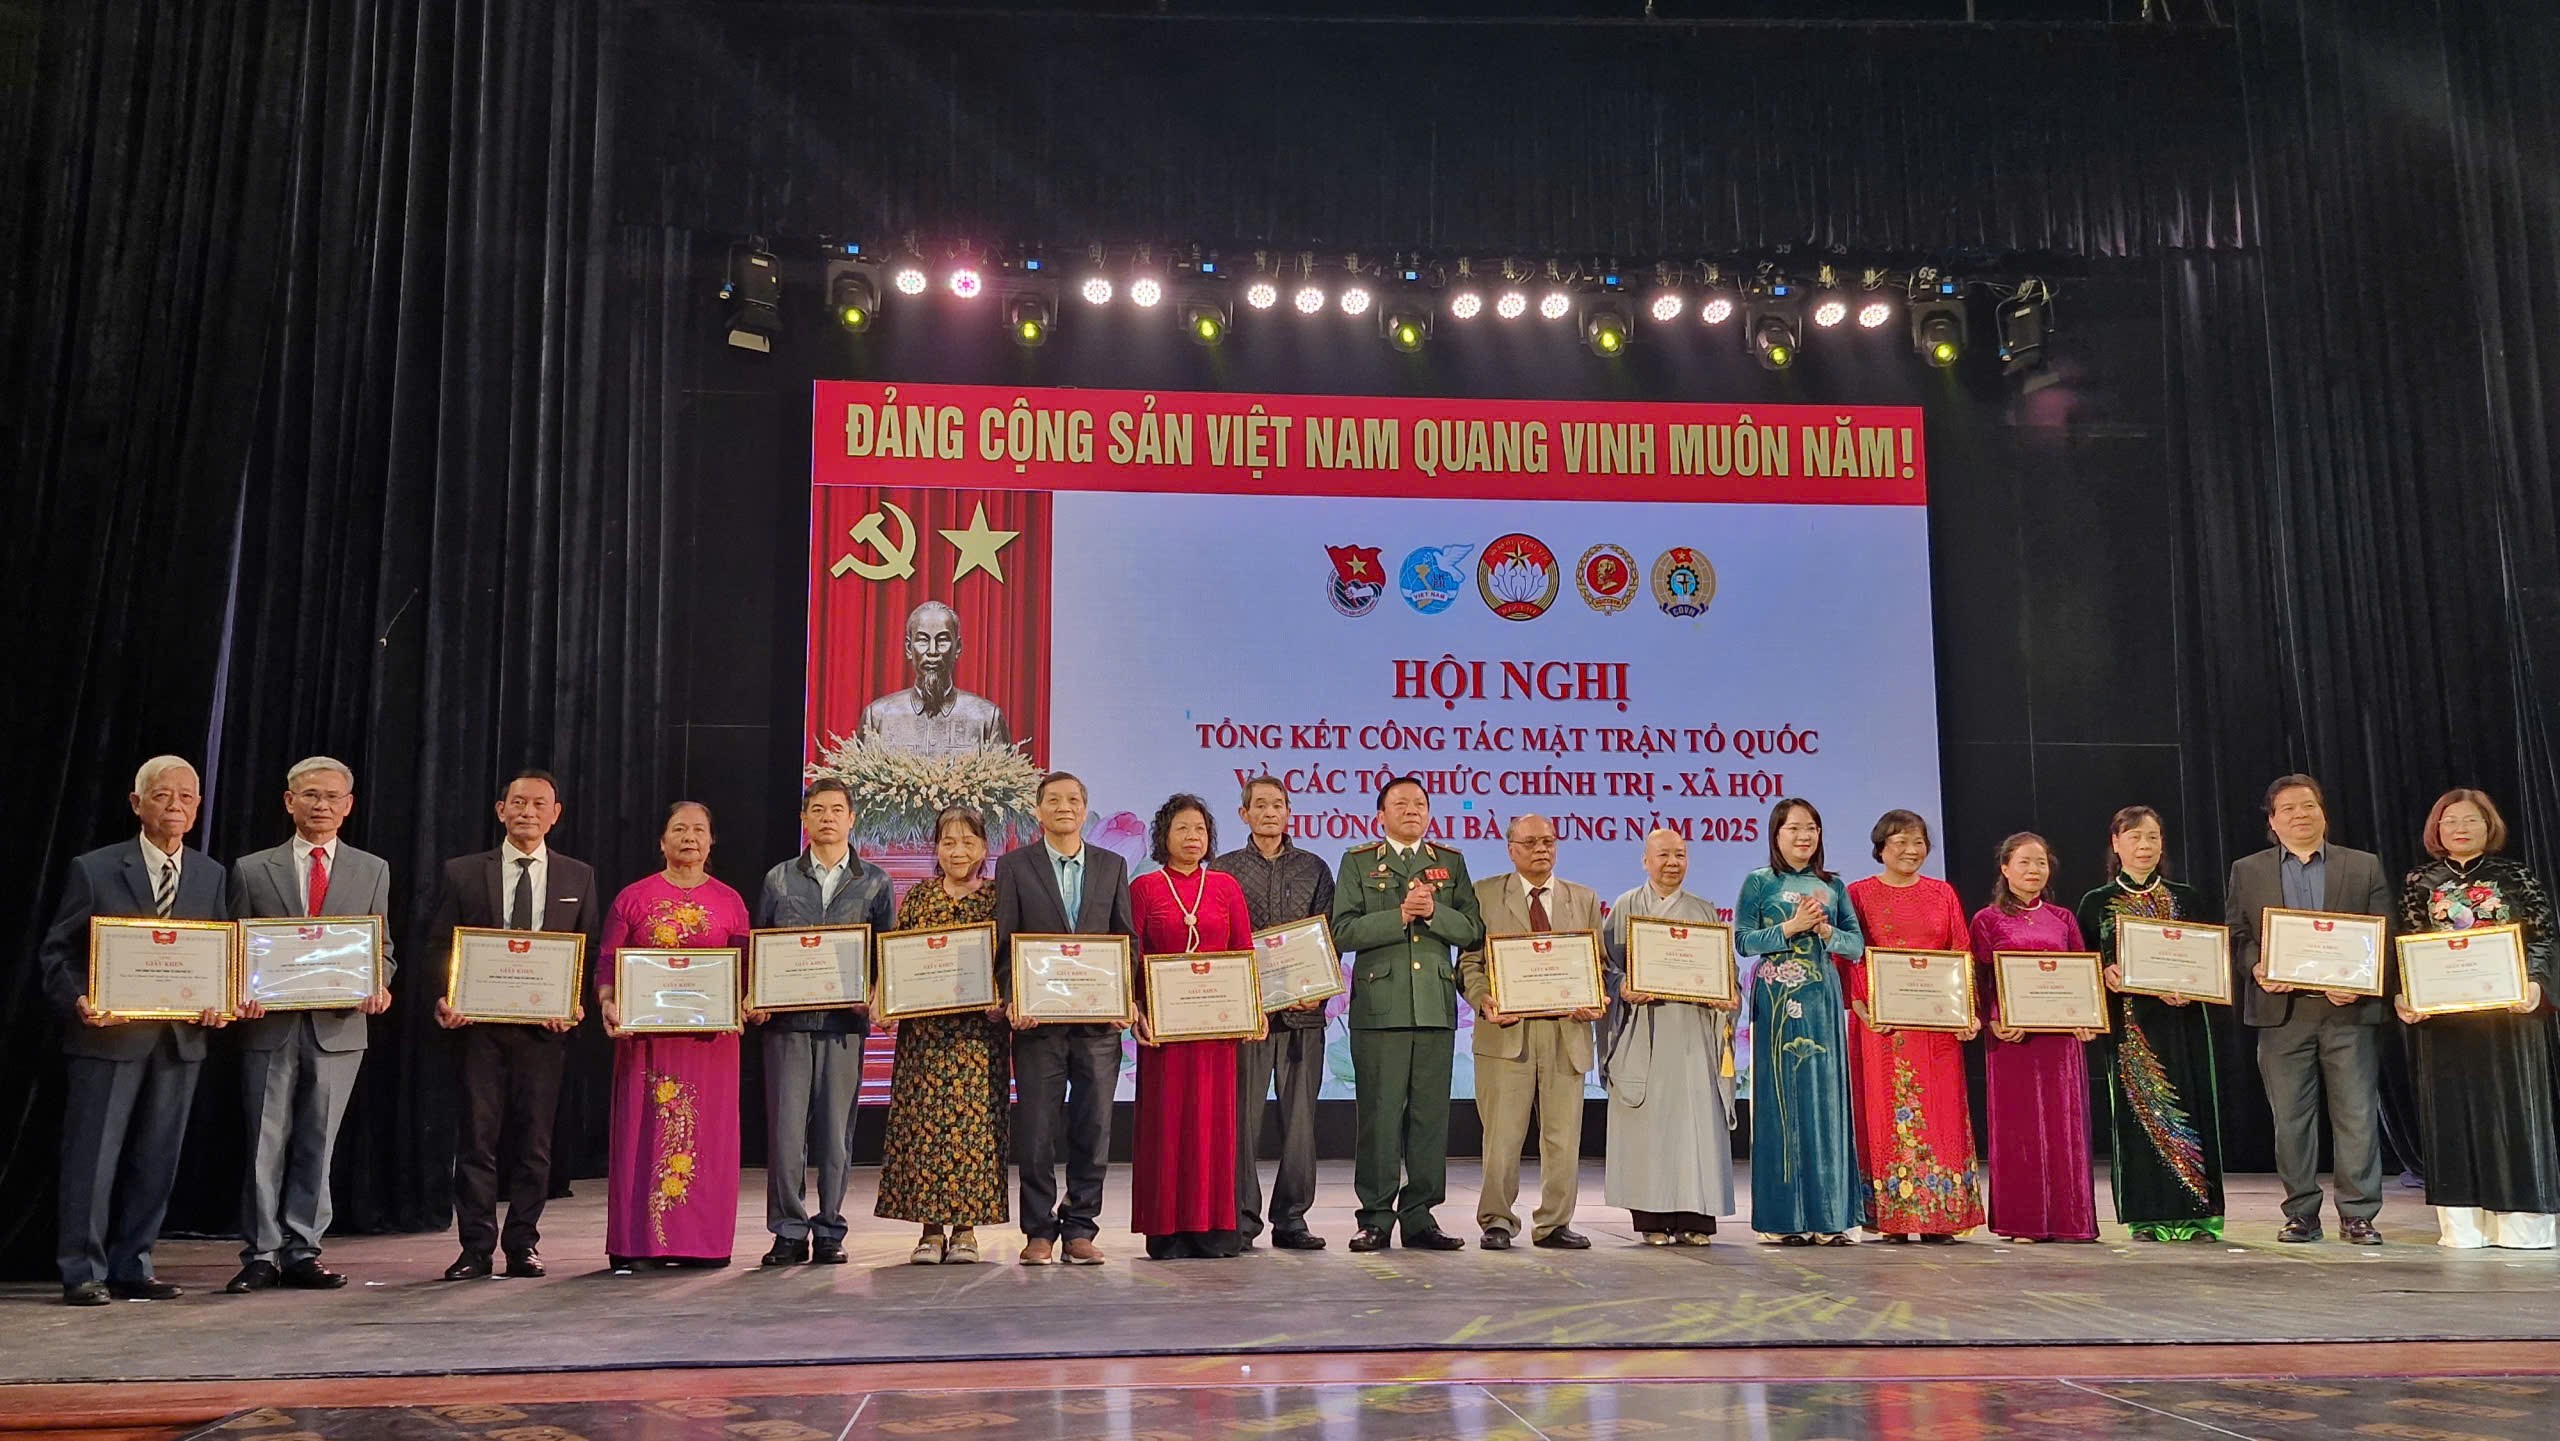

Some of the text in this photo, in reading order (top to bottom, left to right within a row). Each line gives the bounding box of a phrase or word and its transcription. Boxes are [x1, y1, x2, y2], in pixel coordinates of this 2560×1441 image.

[845, 386, 1914, 479] ĐẢNG CỘNG SẢN VIỆT NAM QUANG VINH MUÔN NĂM!
[1391, 653, 1631, 713] HỘI NGHỊ
[1195, 717, 1819, 760] TỔNG KẾT CÔNG TÁC MẶT TRẬN TỔ QUỐC
[1284, 762, 1347, 793] CÁC
[1499, 764, 1597, 797] CHÍNH
[1603, 771, 1655, 803] TRỊ
[1679, 767, 1721, 797] XÃ
[1727, 769, 1785, 804] HỘI
[1423, 815, 1456, 840] AI
[1463, 808, 1504, 840] BÀ
[1700, 817, 1759, 843] 2025
